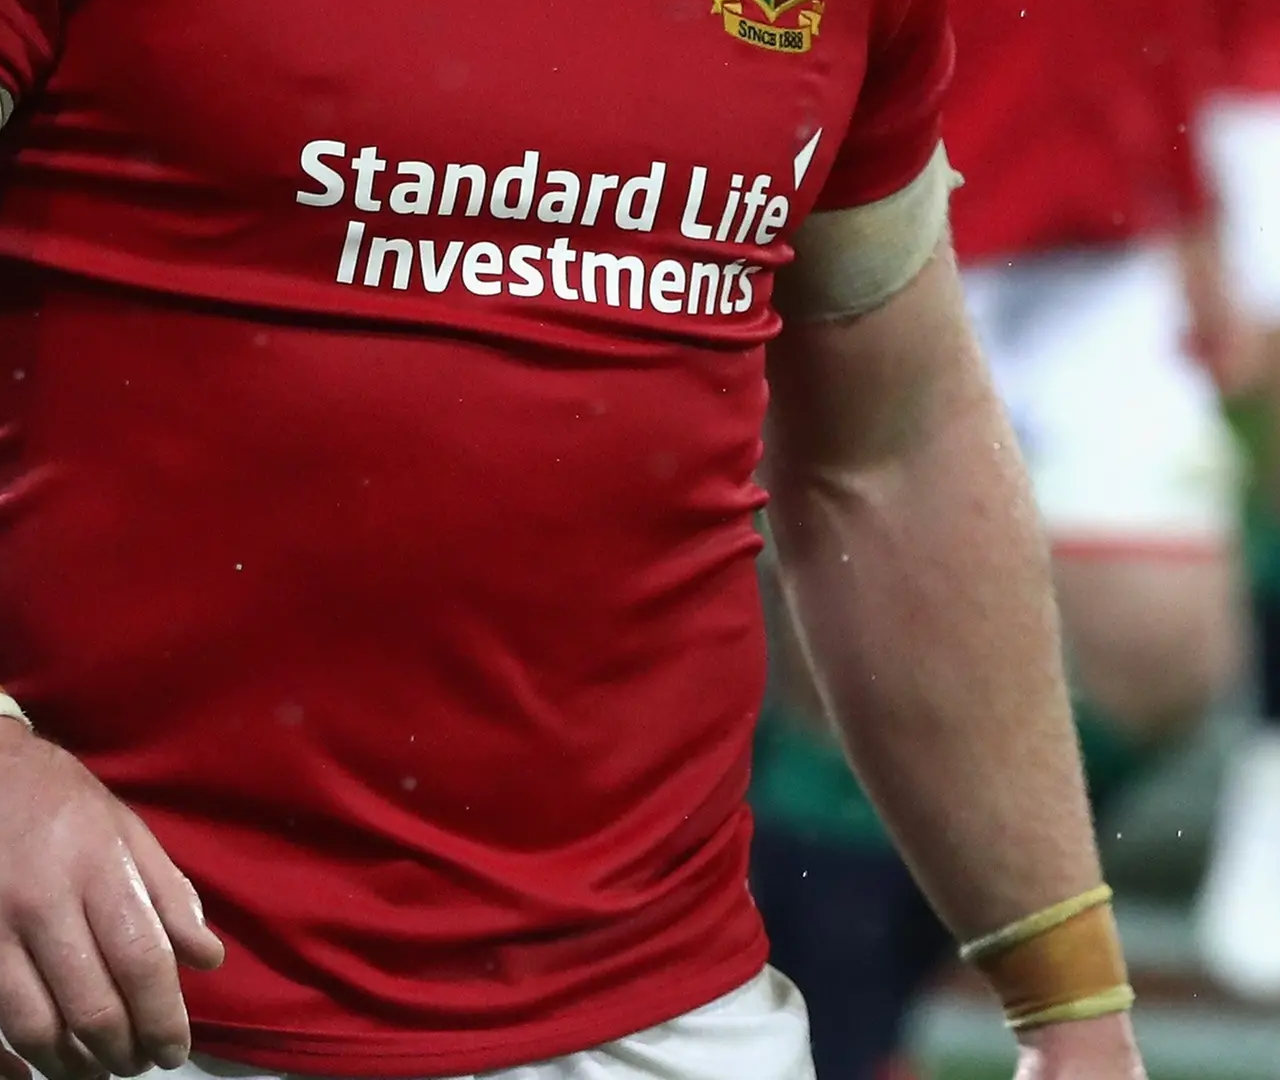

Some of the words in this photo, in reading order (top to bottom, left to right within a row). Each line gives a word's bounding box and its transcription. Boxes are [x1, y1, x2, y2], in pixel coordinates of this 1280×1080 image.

[779, 31, 804, 50] 1888
[296, 139, 667, 232] Standard
[680, 166, 790, 245] Life
[335, 220, 762, 316] Investments
